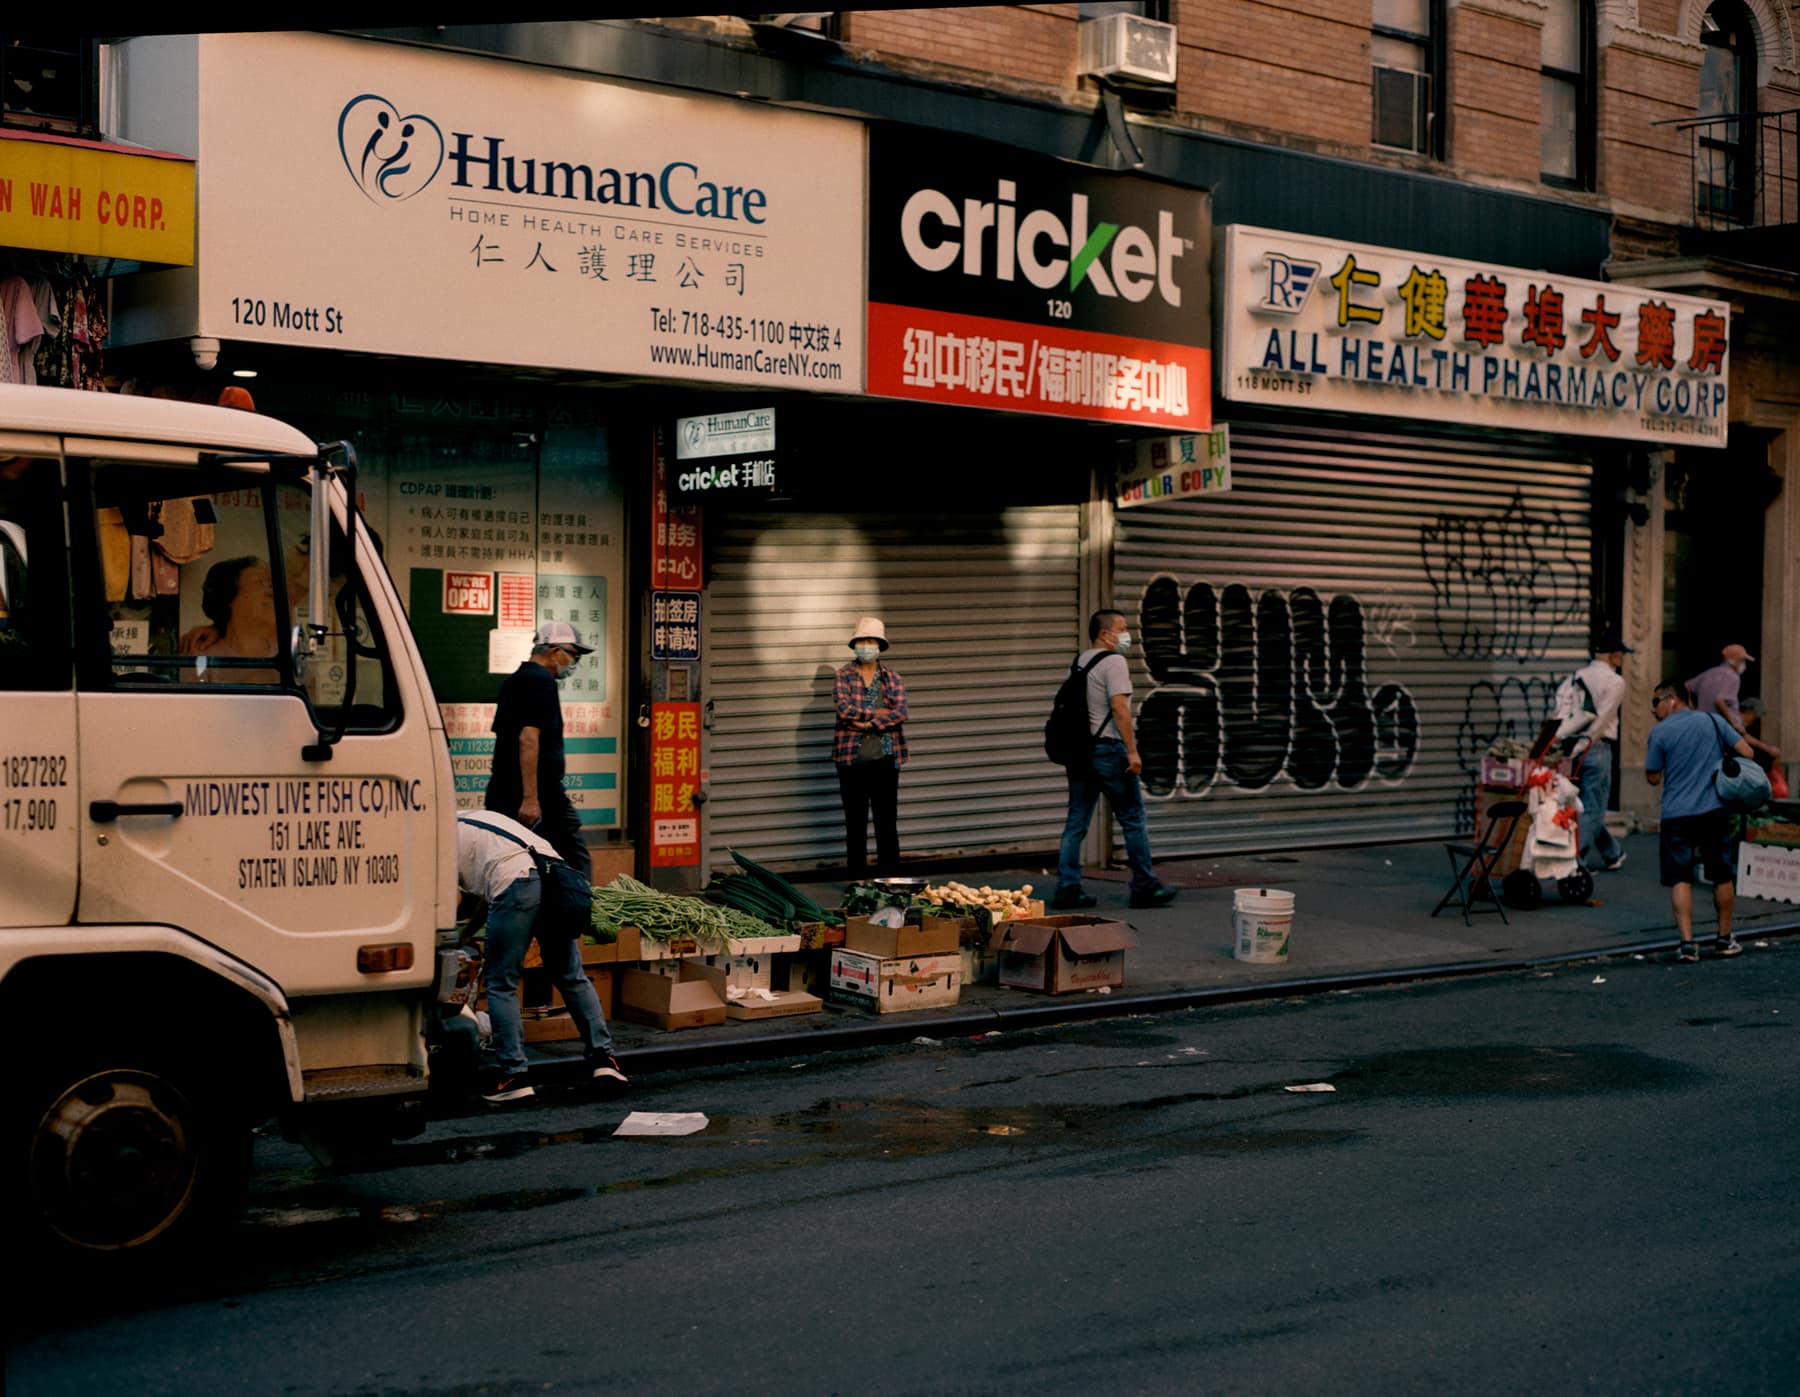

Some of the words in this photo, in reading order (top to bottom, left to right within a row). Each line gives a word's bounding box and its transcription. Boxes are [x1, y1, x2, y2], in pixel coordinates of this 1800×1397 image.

[449, 131, 768, 224] HumanCare
[30, 182, 81, 221] WAH
[97, 191, 165, 231] CORP.
[450, 206, 509, 228] HOME
[523, 213, 602, 238] HEALTH
[614, 224, 664, 246] CARE
[675, 233, 765, 259] SERVICES
[901, 178, 1184, 308] cricket
[469, 232, 748, 297] 仁人護理公司
[231, 297, 266, 327] 120
[273, 302, 320, 333] Mott
[325, 306, 343, 335] St
[1046, 299, 1073, 320] 120
[1330, 253, 1727, 376] 仁健華埠大藥房
[650, 307, 677, 334] Tel:
[682, 310, 785, 345] 718-435-1100
[789, 321, 830, 353] 中文按
[833, 327, 842, 350] 4
[650, 344, 842, 380] www.HumanCareNY.com
[903, 327, 1189, 417] 纽中移民/福利服务中心
[1262, 328, 1327, 374] ALL
[1341, 336, 1470, 393] HEALTH
[1483, 355, 1647, 410] PHARMACY
[1656, 377, 1726, 417] CORP
[1262, 378, 1293, 392] MOTT
[1297, 382, 1313, 395] ST
[708, 413, 771, 433] HumanCare
[400, 482, 442, 497] CDPAP
[678, 463, 739, 492] cricket
[1121, 475, 1173, 501] COLOR
[1181, 466, 1226, 492] COPY
[656, 523, 697, 547] 服务
[450, 575, 488, 589] WE'RE
[656, 555, 697, 580] 中心
[447, 588, 490, 610] OPEN
[655, 711, 698, 741] 移民
[2, 756, 67, 788] 1827282
[654, 746, 698, 777] 福利
[185, 781, 270, 816] MIDWEST
[276, 780, 310, 814] LIVE
[317, 780, 353, 814] FISH
[654, 782, 696, 813] 服务
[269, 821, 290, 851] 151
[299, 820, 330, 851] LAKE
[338, 820, 365, 849] AVE.
[238, 857, 286, 889] STATEN
[293, 856, 338, 887] ISLAND
[344, 856, 359, 885] NY
[365, 854, 399, 885] 10303
